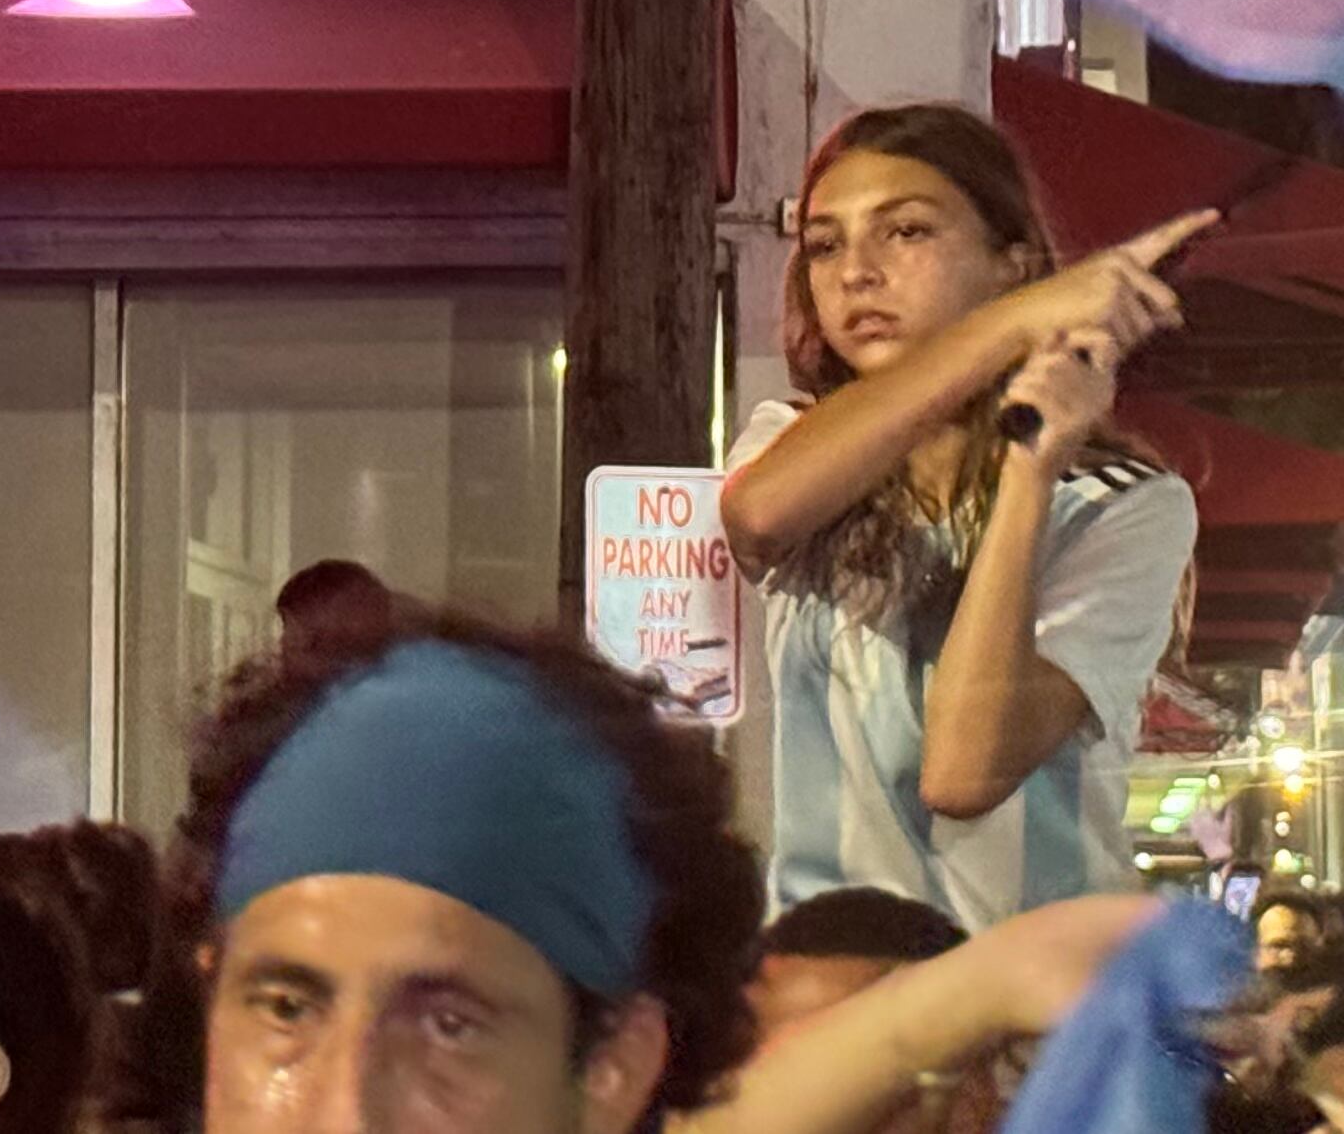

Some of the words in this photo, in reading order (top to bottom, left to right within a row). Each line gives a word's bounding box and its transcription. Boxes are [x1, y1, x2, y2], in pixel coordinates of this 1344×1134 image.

[639, 486, 693, 527] NO
[603, 538, 729, 580] PARKING
[640, 588, 692, 617] ANY
[637, 628, 690, 657] TIME
